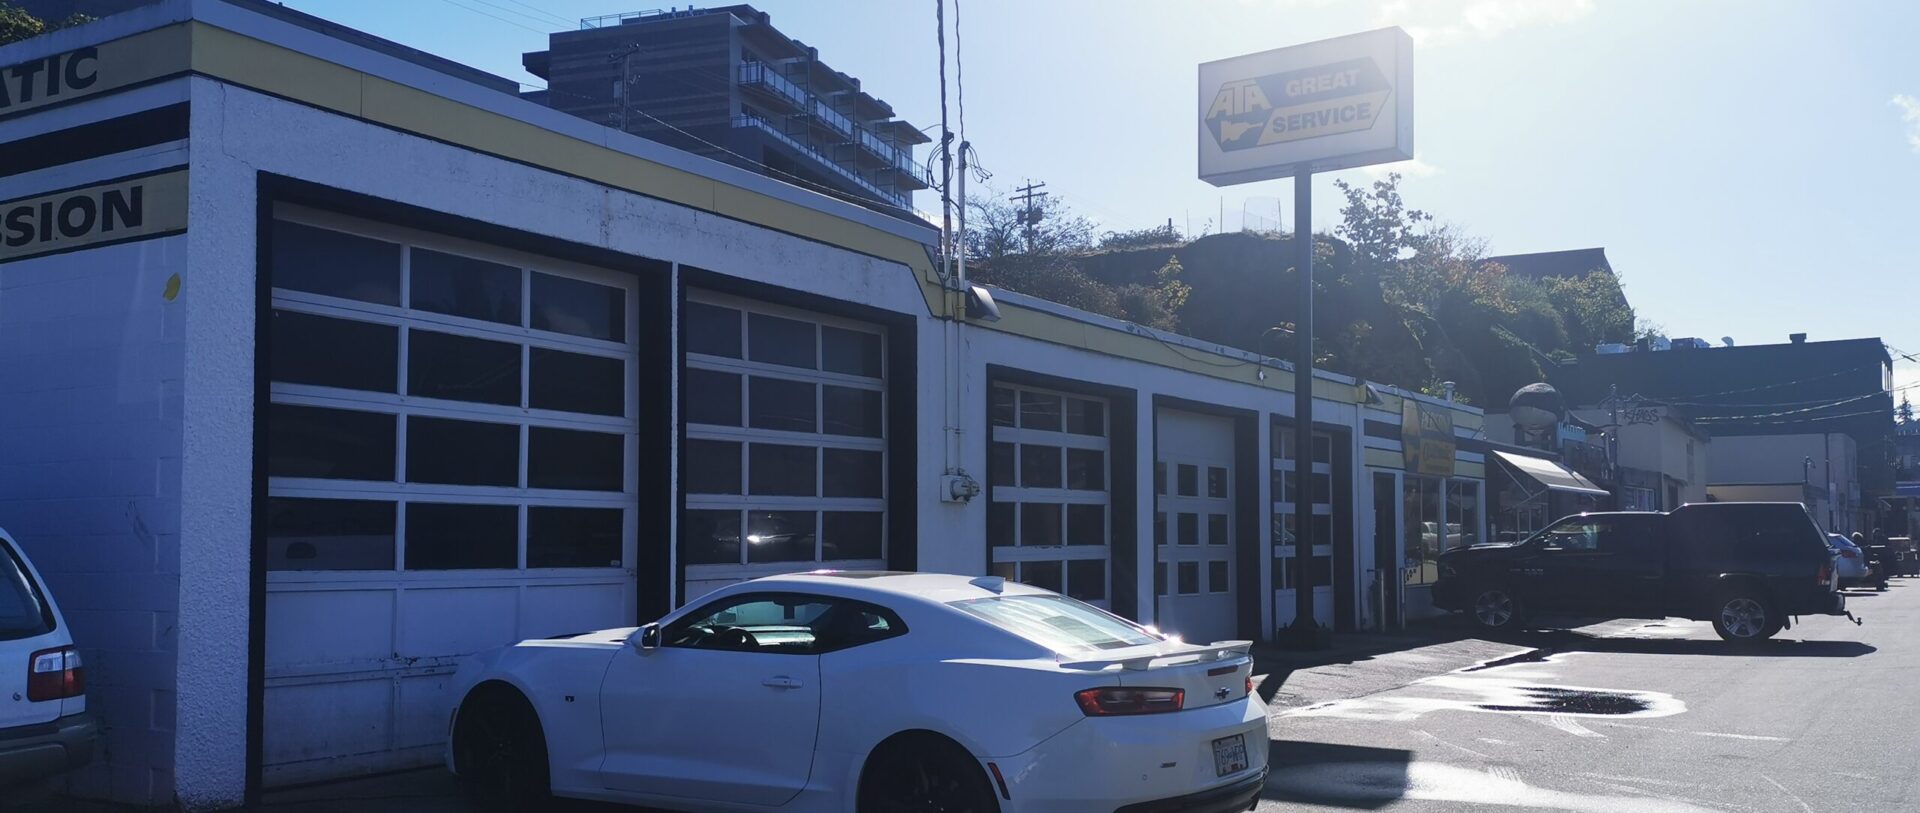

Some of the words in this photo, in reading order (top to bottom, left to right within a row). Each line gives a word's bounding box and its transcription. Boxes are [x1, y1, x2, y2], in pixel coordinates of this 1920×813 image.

[1207, 78, 1272, 119] ATA
[1285, 68, 1361, 97] GREAT
[1272, 102, 1372, 134] SERVICE
[0, 186, 143, 247] SION
